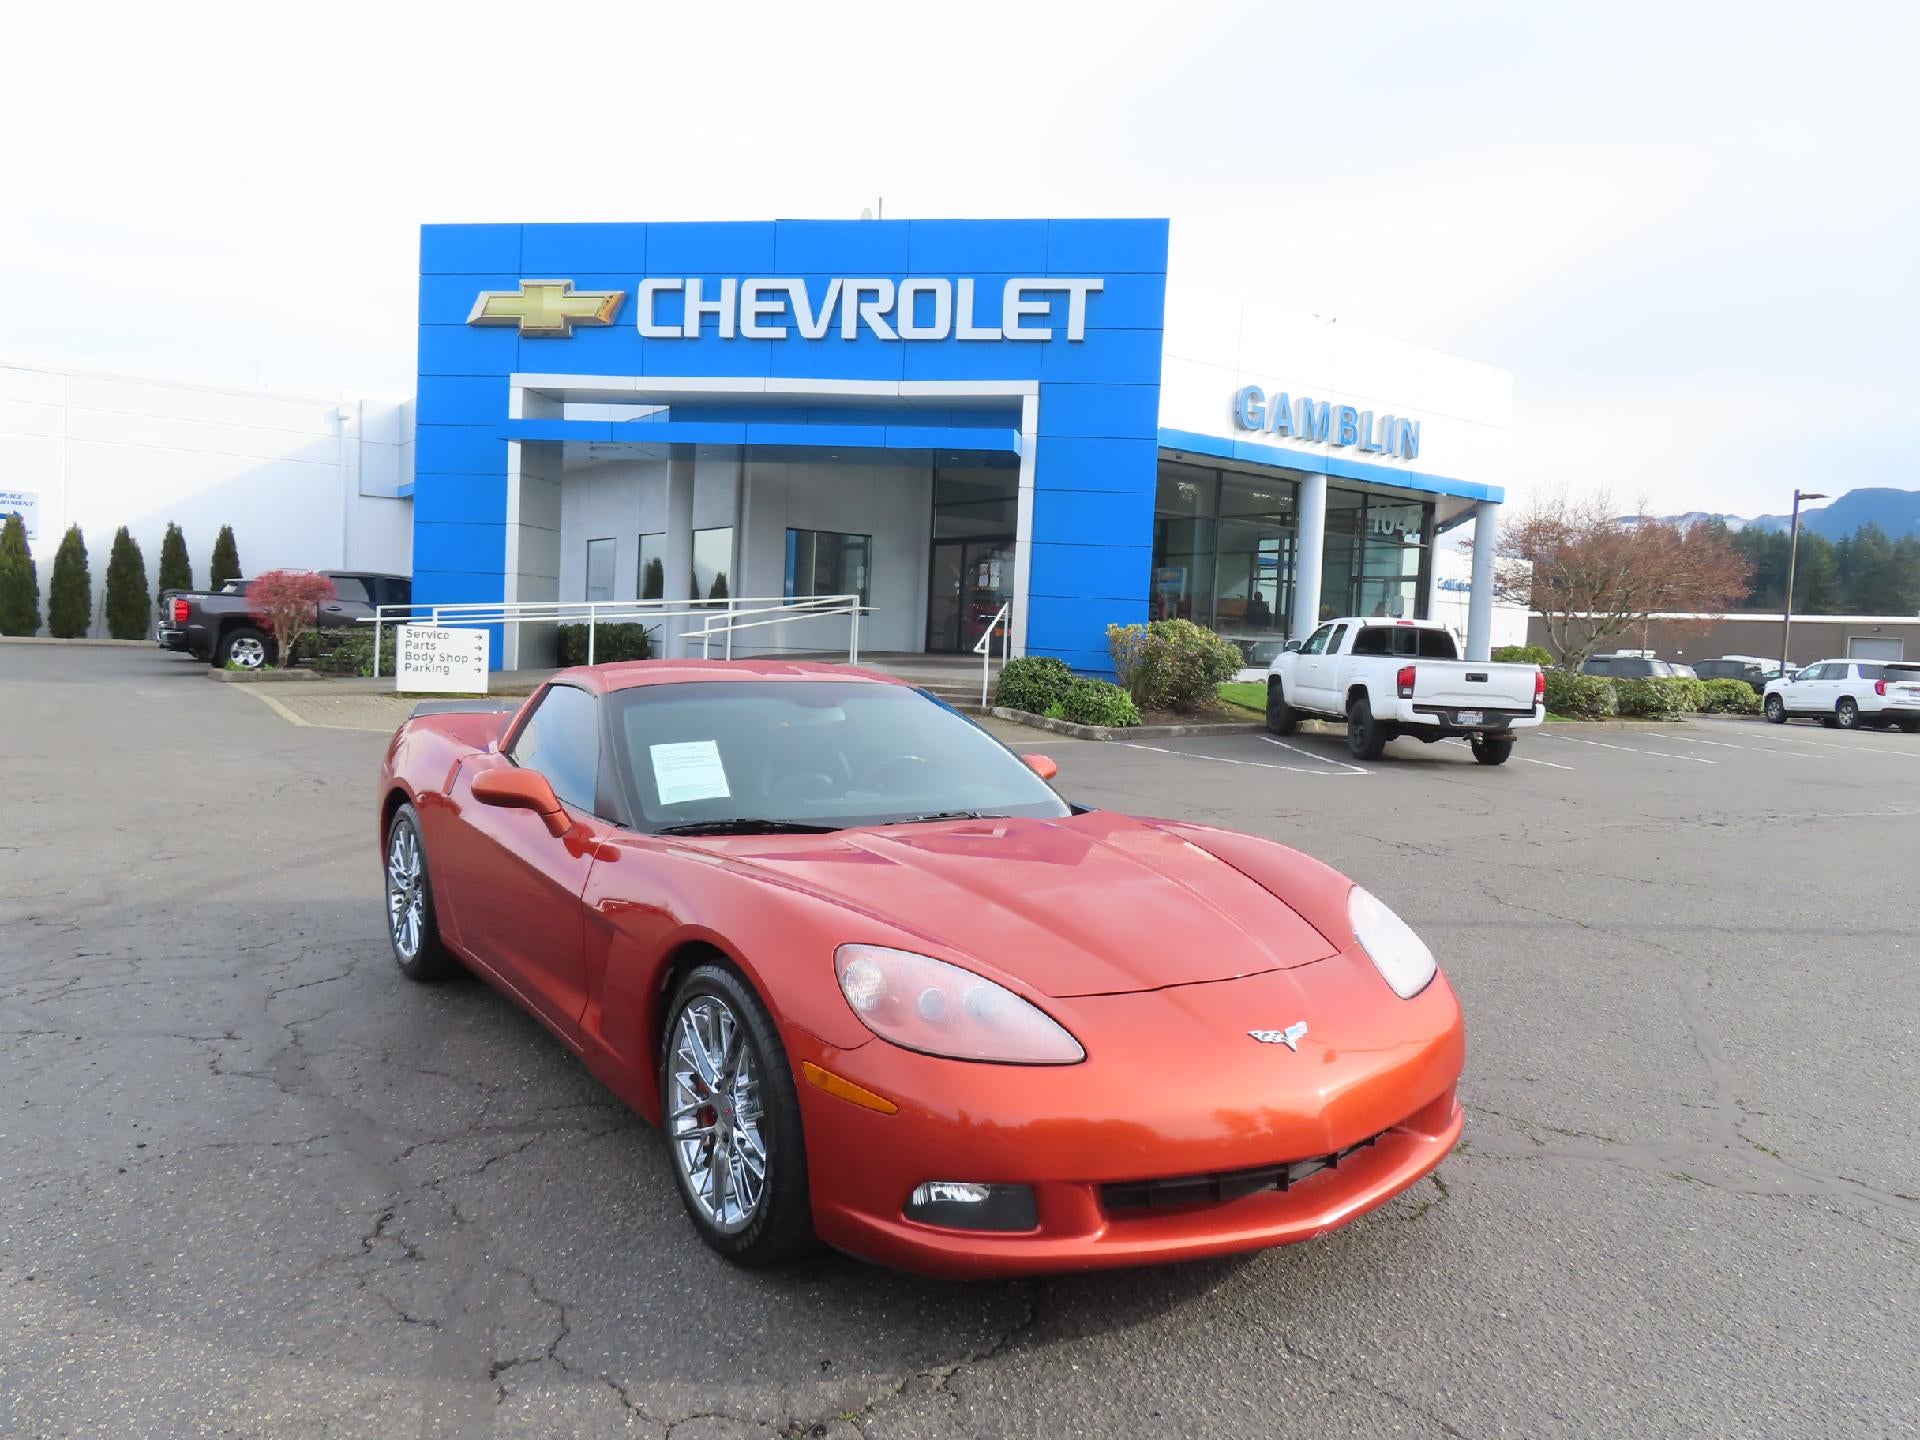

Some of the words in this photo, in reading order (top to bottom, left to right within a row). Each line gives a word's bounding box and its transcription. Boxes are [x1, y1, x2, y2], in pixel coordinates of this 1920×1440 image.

[637, 278, 1104, 341] CHEVROLET
[1235, 385, 1420, 459] GAMBLIN
[406, 629, 450, 640] Service
[405, 640, 437, 651] Parts
[405, 651, 435, 664] Body
[439, 653, 469, 665] Shop
[405, 662, 450, 676] Parking
